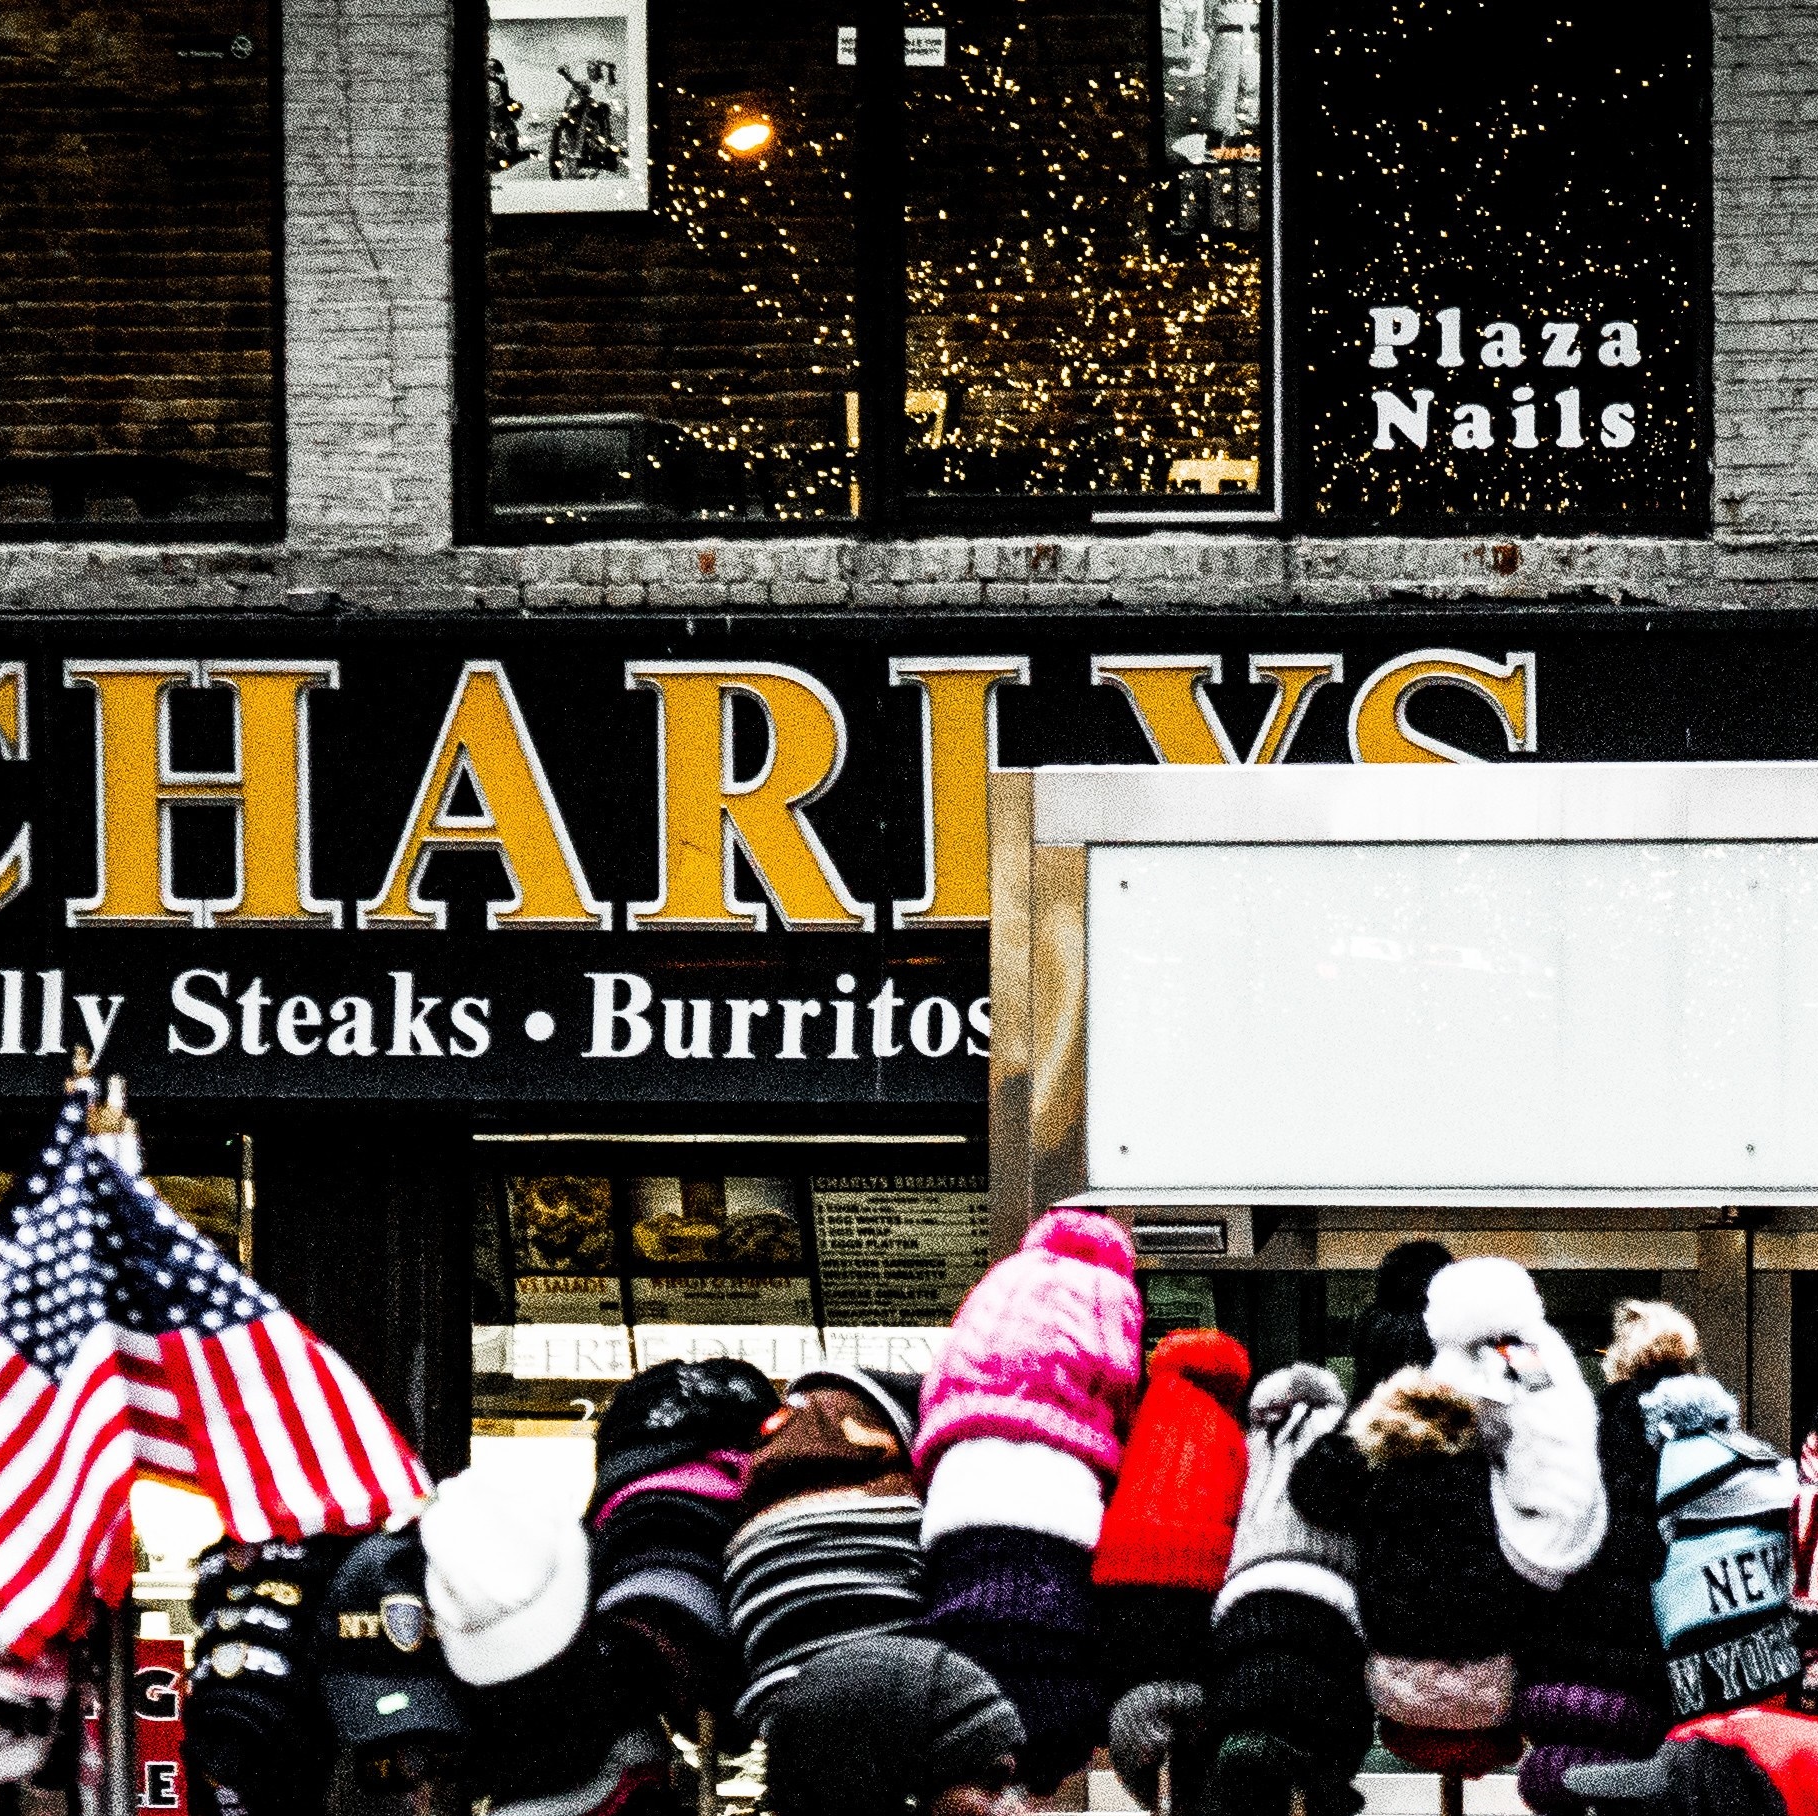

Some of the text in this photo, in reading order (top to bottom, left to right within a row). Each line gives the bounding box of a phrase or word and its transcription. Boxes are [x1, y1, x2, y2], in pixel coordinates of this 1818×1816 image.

[1369, 306, 1641, 368] Plaza
[1371, 387, 1637, 450] Nails
[167, 968, 492, 1060] Steaks
[582, 970, 990, 1060] Burritos
